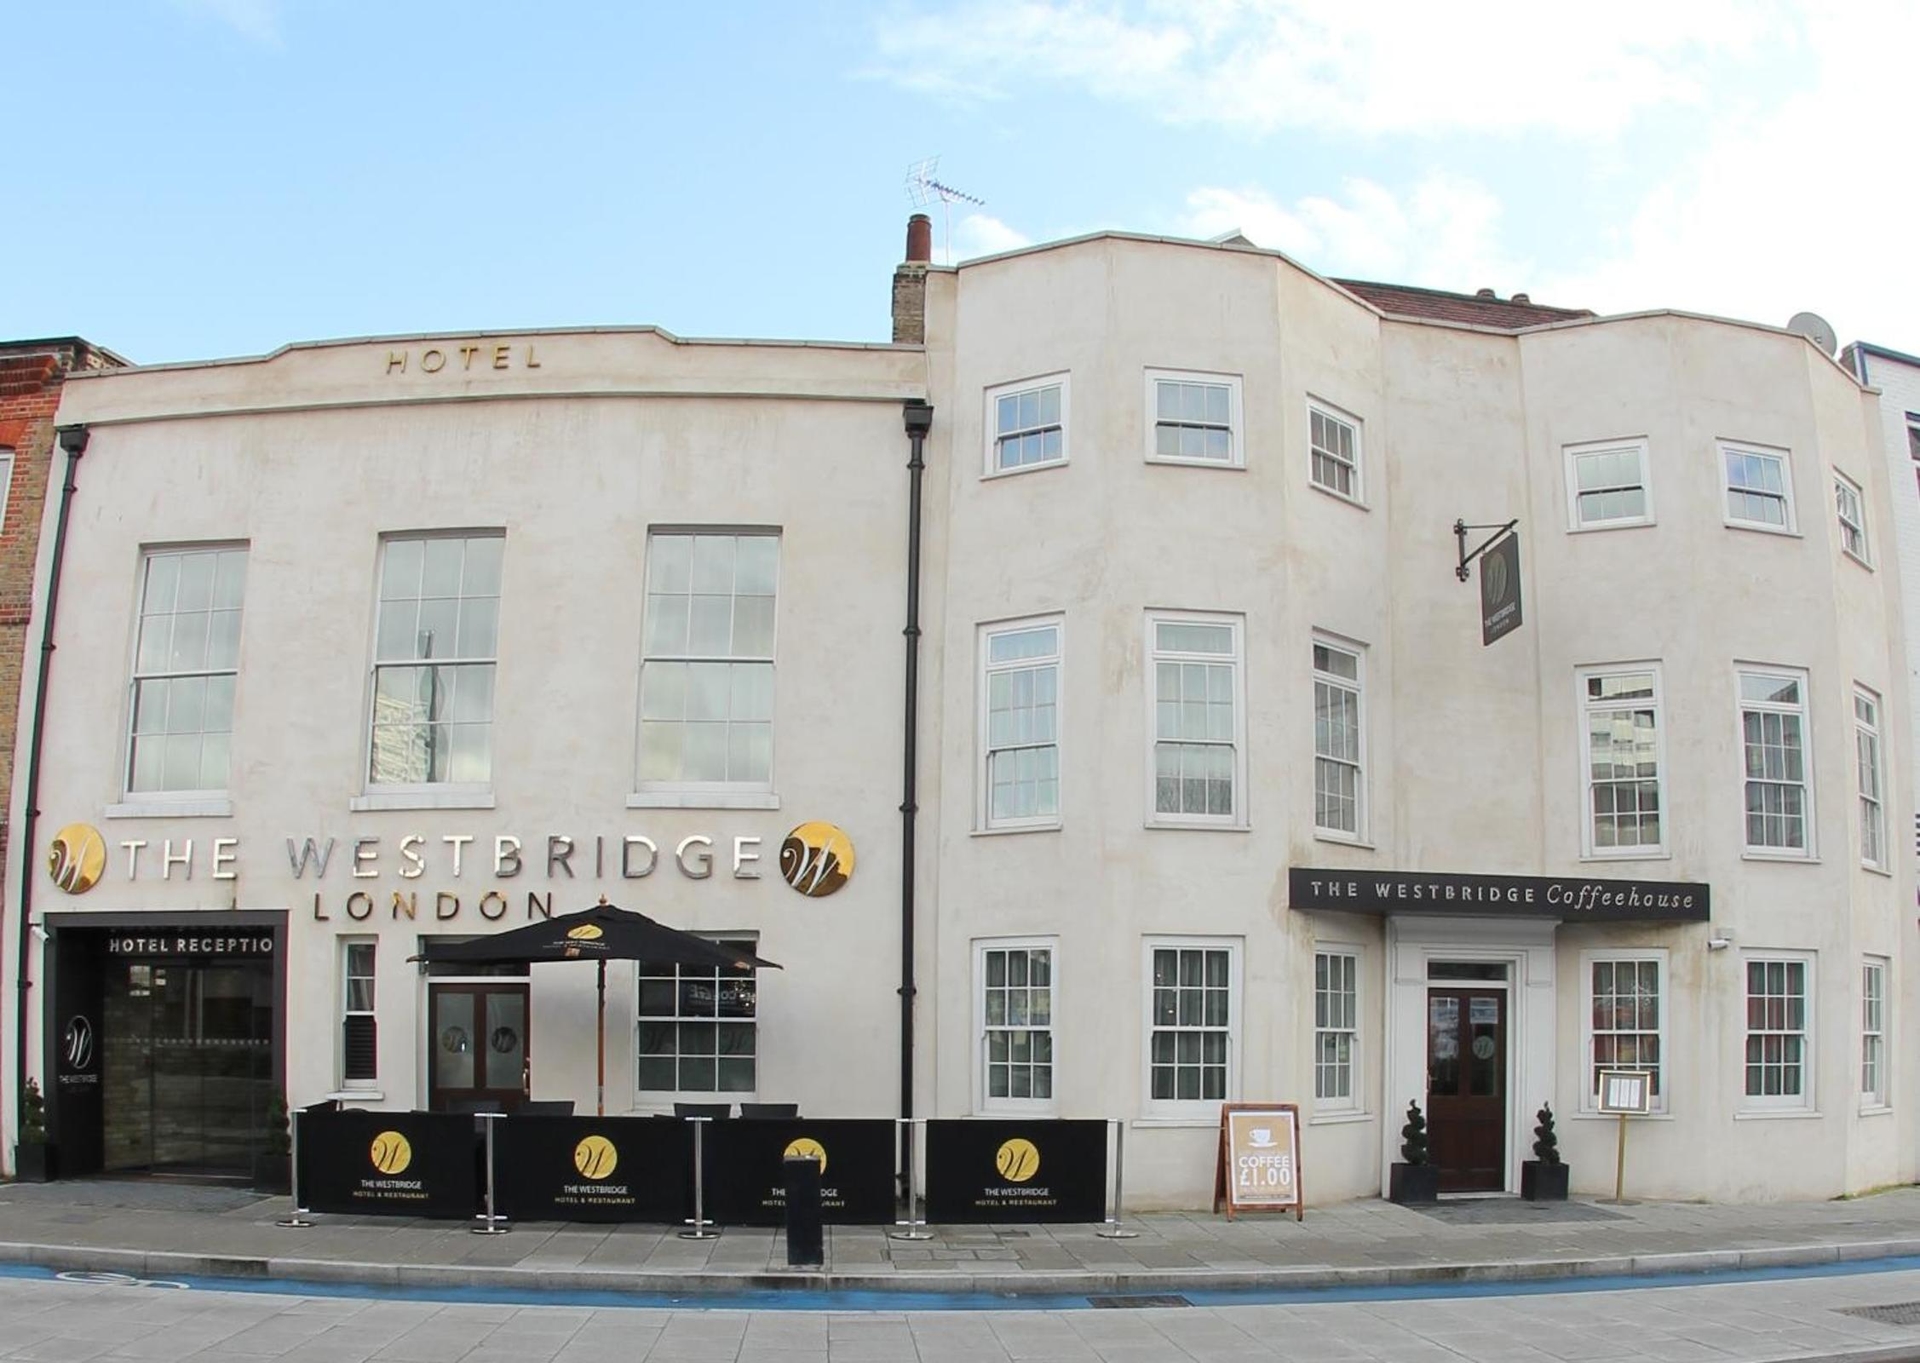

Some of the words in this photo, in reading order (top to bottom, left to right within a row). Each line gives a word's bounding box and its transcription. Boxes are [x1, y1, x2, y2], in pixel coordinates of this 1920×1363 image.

[386, 344, 541, 375] HOTEL
[121, 838, 238, 881] THE
[287, 834, 761, 880] WESTBRIDGE
[1311, 881, 1358, 897] THE
[1375, 883, 1534, 902] WESTBRIDGE
[1547, 884, 1693, 910] Coffeehouse
[314, 891, 553, 921] LONDON
[110, 938, 168, 952] HOTEL
[177, 938, 273, 952] RECEPTIO
[1239, 1156, 1290, 1168] COFFEE
[361, 1179, 373, 1188] THE
[374, 1180, 422, 1189] WESTBRIDGE
[1240, 1168, 1290, 1186] £1.00
[564, 1185, 578, 1194] THE
[579, 1185, 627, 1194] WESTBRIDGE
[772, 1188, 786, 1196] THE
[984, 1188, 999, 1196] THE
[1000, 1188, 1049, 1197] WESTBRIDGE
